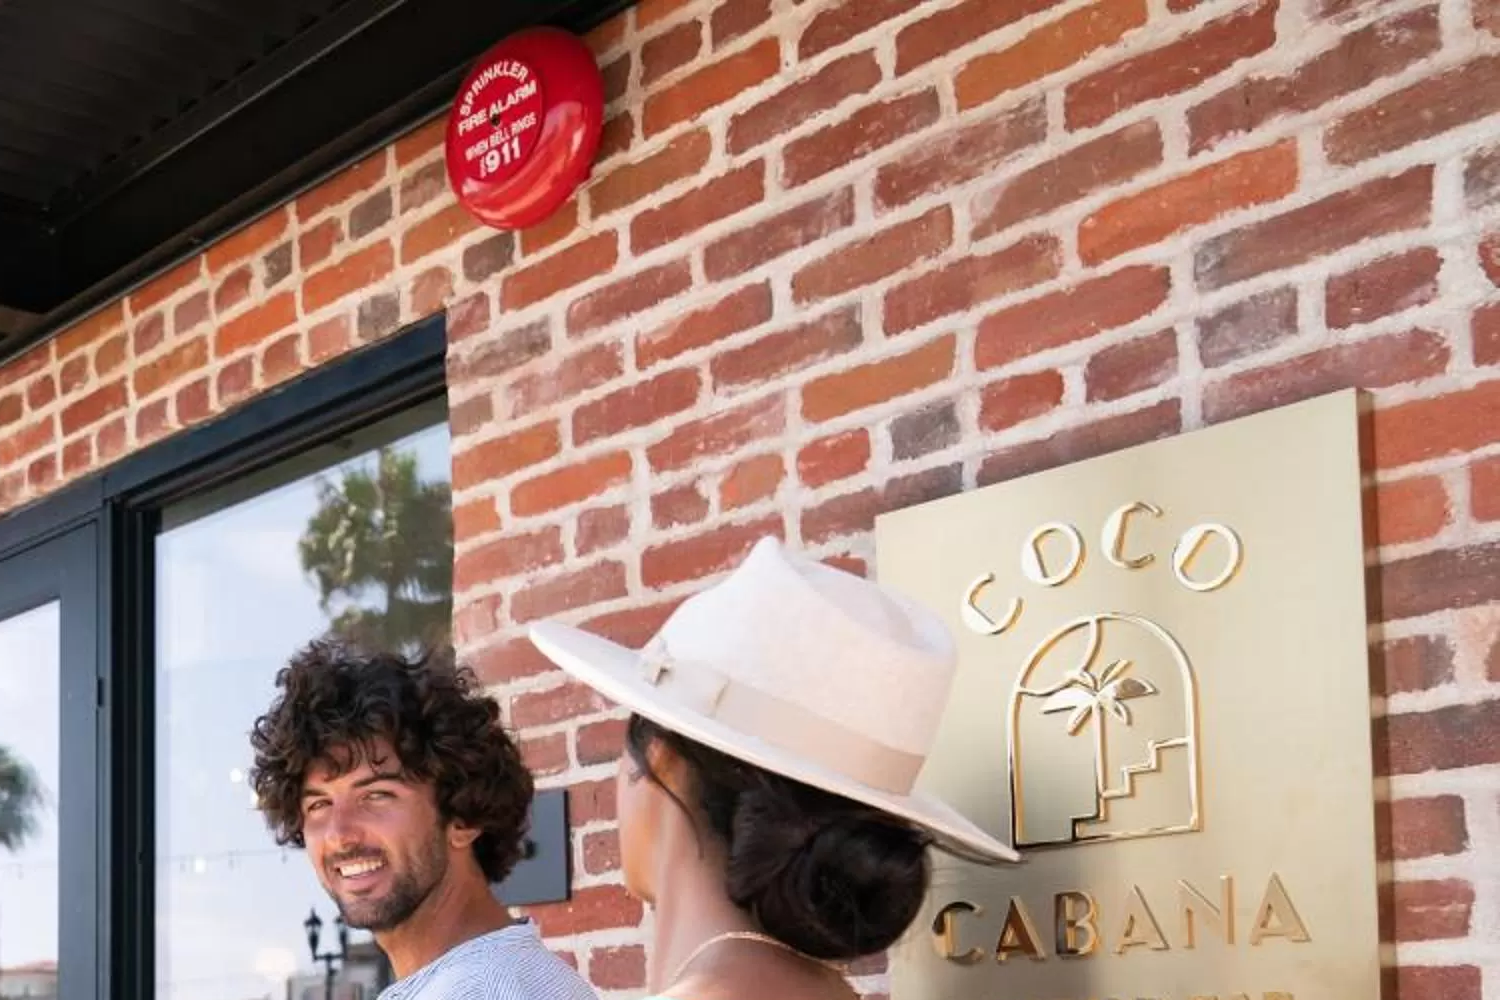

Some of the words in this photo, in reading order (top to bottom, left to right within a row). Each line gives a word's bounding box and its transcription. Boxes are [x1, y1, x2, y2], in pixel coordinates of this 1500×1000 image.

[458, 108, 487, 136] FIRE
[490, 79, 537, 118] ALARM
[460, 60, 528, 116] SPRINKLER
[960, 500, 1245, 635] COCO
[932, 872, 1312, 963] CABANA
